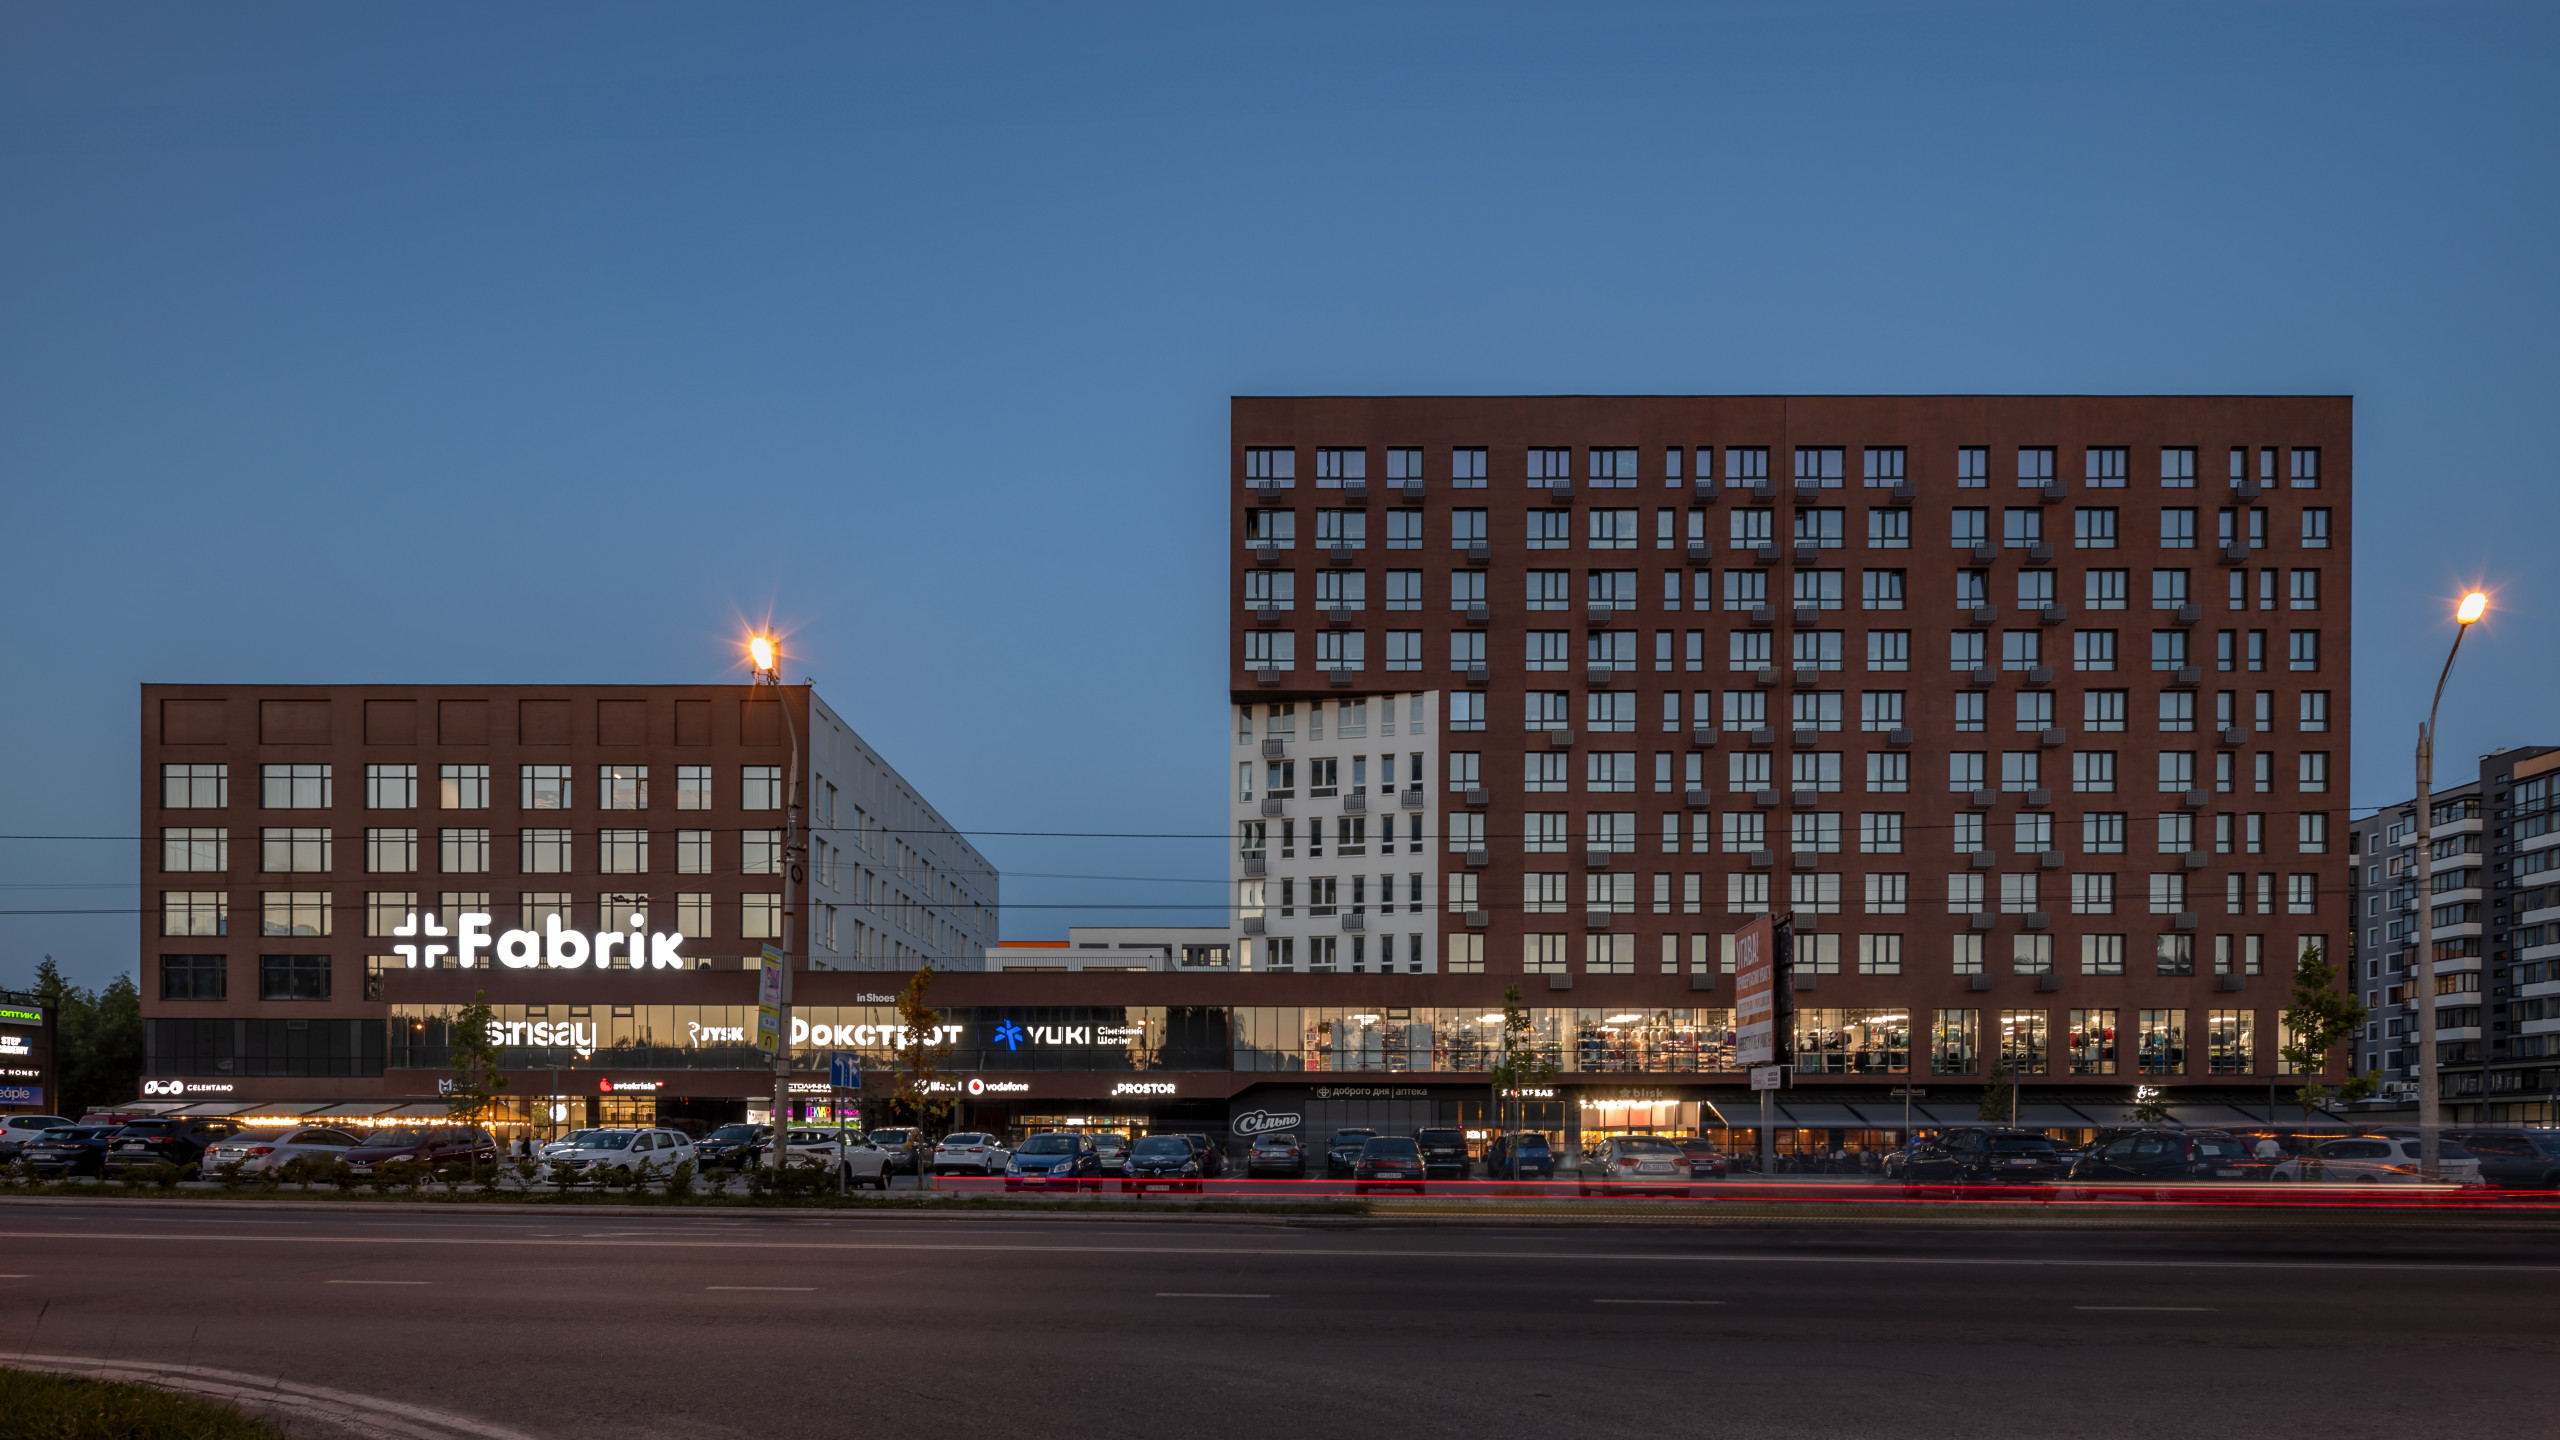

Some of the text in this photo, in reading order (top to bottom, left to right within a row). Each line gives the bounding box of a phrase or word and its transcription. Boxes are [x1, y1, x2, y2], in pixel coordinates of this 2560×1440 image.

[458, 912, 684, 970] Fabrik
[0, 1010, 41, 1020] ОПТИКА
[700, 1026, 744, 1042] JYSK
[1026, 1026, 1090, 1045] YUKI
[1097, 1026, 1143, 1035] Сімейний
[1, 1036, 21, 1046] STEP
[485, 1021, 597, 1056] sinsay
[9, 1069, 40, 1077] HONEY
[187, 1084, 233, 1092] CELENTANO
[986, 1081, 1029, 1091] vodafone
[1332, 1087, 1428, 1097] доброго дня аптека
[1633, 1088, 1664, 1098] blisk
[1240, 1113, 1298, 1133] Сільпо
